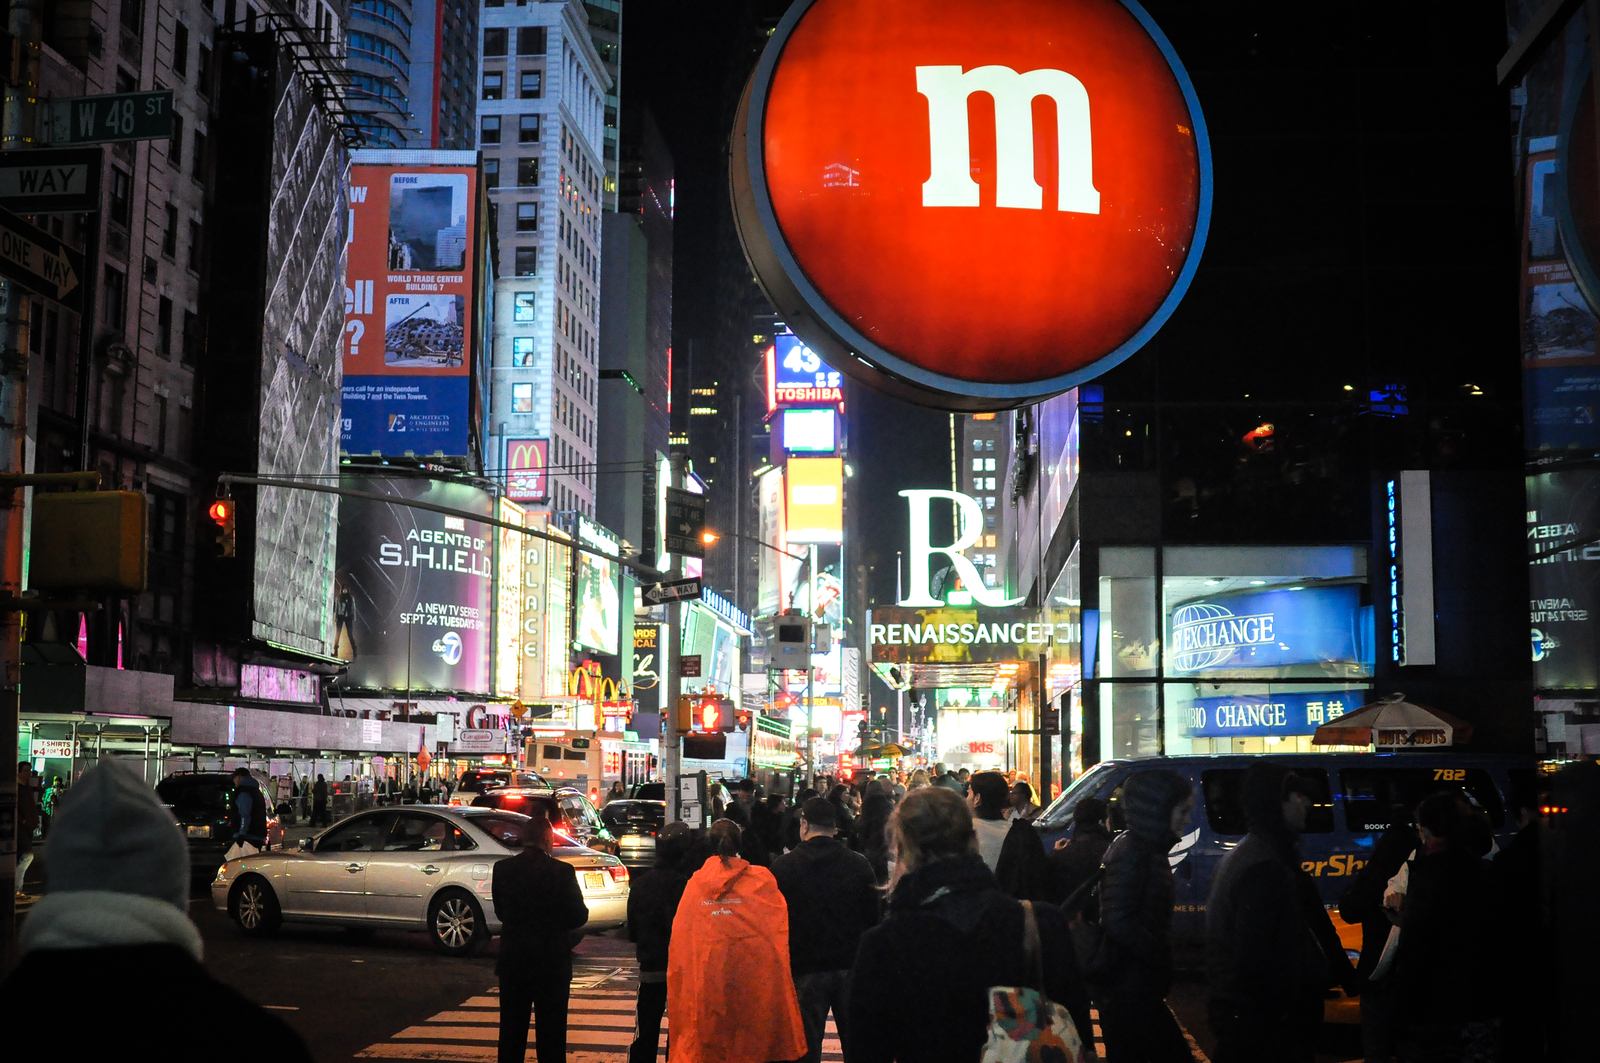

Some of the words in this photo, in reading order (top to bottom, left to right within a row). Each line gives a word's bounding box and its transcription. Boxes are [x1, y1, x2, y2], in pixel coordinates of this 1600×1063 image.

[79, 102, 97, 137] W
[106, 99, 135, 135] 48
[145, 97, 165, 116] ST
[915, 65, 1100, 215] m
[19, 167, 76, 193] WAY
[2, 231, 32, 268] ONE
[43, 252, 71, 288] WAY
[387, 275, 411, 283] WORLD
[413, 275, 435, 283] TRADE
[437, 275, 463, 283] CENTER
[405, 283, 438, 291] BUILDING
[440, 283, 444, 291] 7
[775, 388, 843, 400] TOSHIBA
[515, 478, 537, 491] 24
[509, 490, 544, 498] HOURS
[406, 528, 471, 548] AGENTS
[473, 537, 486, 551] OF
[898, 489, 1026, 608] R
[379, 543, 493, 580] S.H.I.E.L.D.
[651, 588, 668, 599] ONE
[677, 584, 695, 596] WAY
[415, 602, 424, 613] A
[425, 603, 448, 615] NEW
[448, 604, 460, 616] TV
[459, 605, 480, 619] SERIES
[400, 612, 425, 625] SEPT
[426, 614, 438, 626] 24
[439, 615, 475, 630] TUESDAYS
[870, 623, 1041, 645] RENAISSANCE
[1183, 616, 1276, 650] EXCHANGE
[1216, 703, 1287, 728] CHANGE
[39, 747, 46, 756] 4
[59, 747, 71, 757] 10
[968, 741, 994, 754] tkts
[1433, 768, 1466, 781] 782
